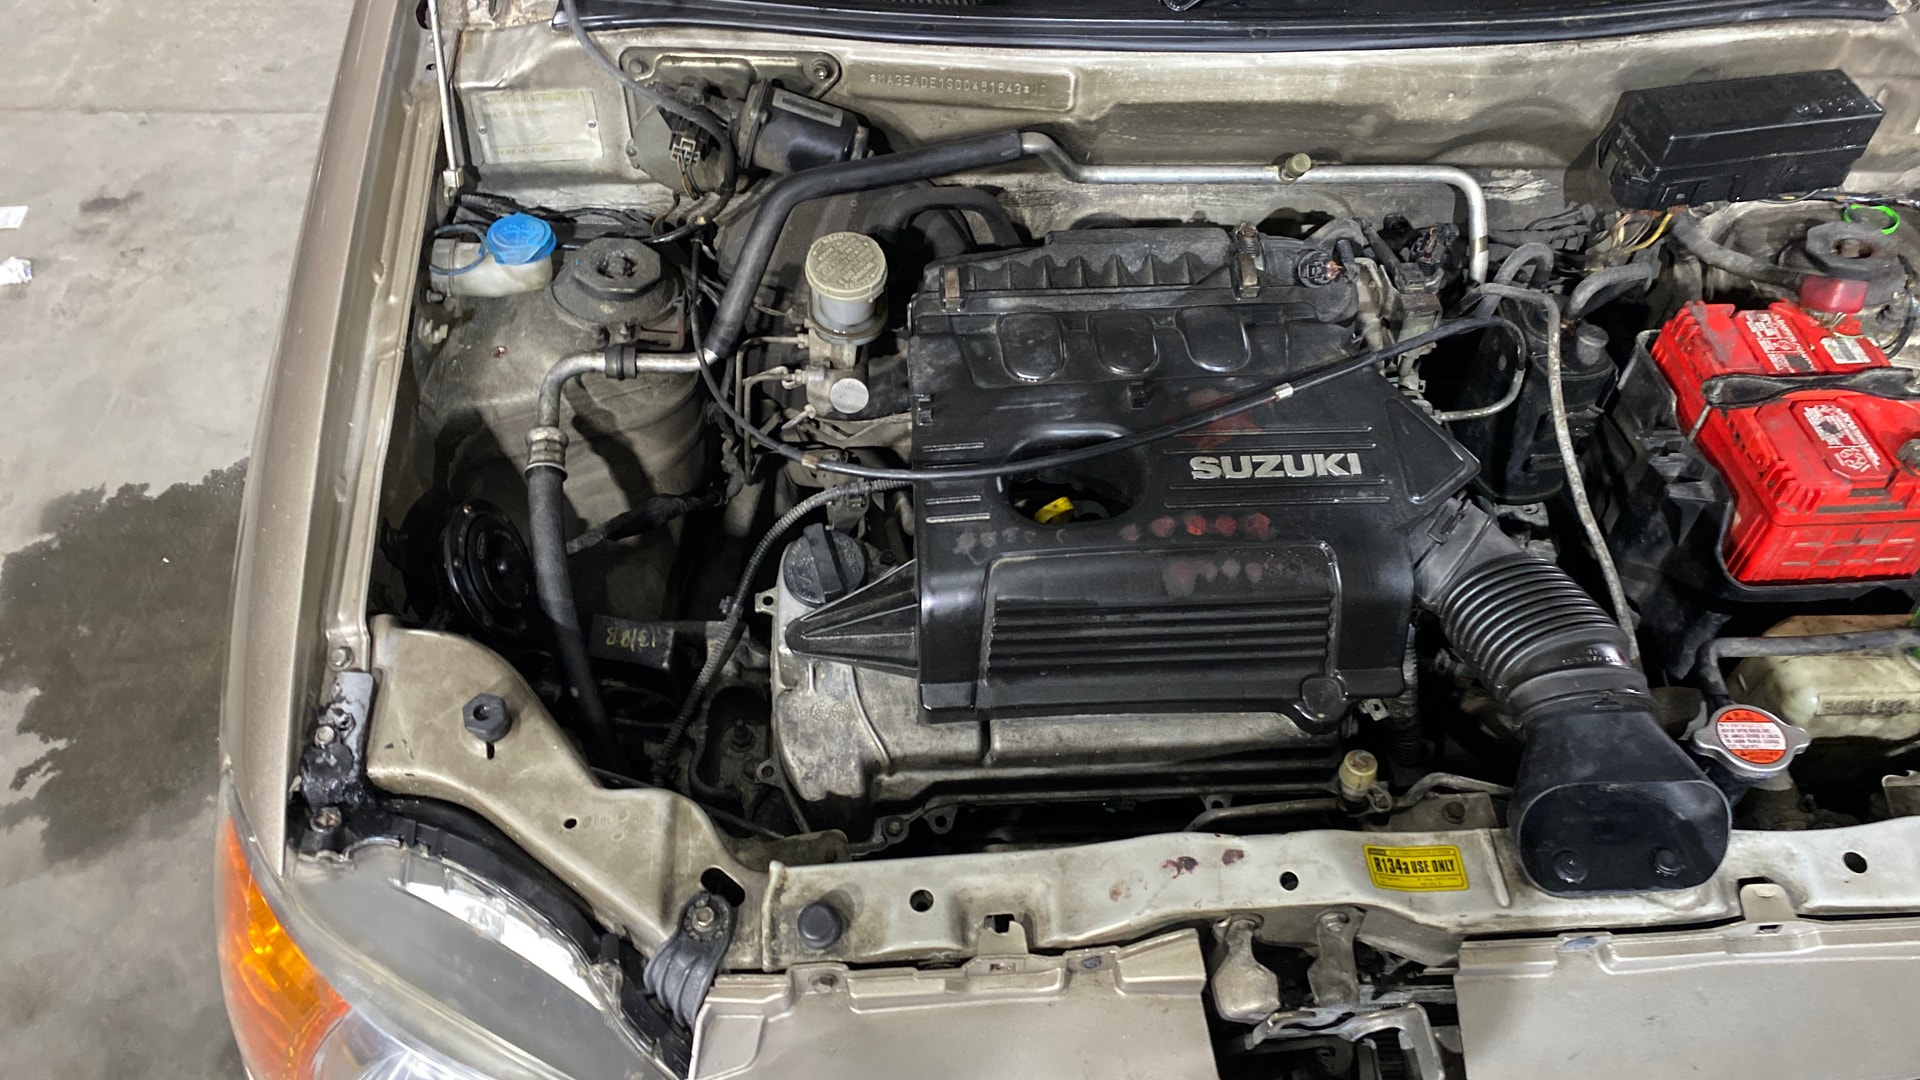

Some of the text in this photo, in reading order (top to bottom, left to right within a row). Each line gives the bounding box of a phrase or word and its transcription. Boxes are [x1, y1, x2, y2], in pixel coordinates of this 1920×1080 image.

[1190, 453, 1362, 479] SUZUKI
[1374, 857, 1455, 873] R134a USE ONLY
